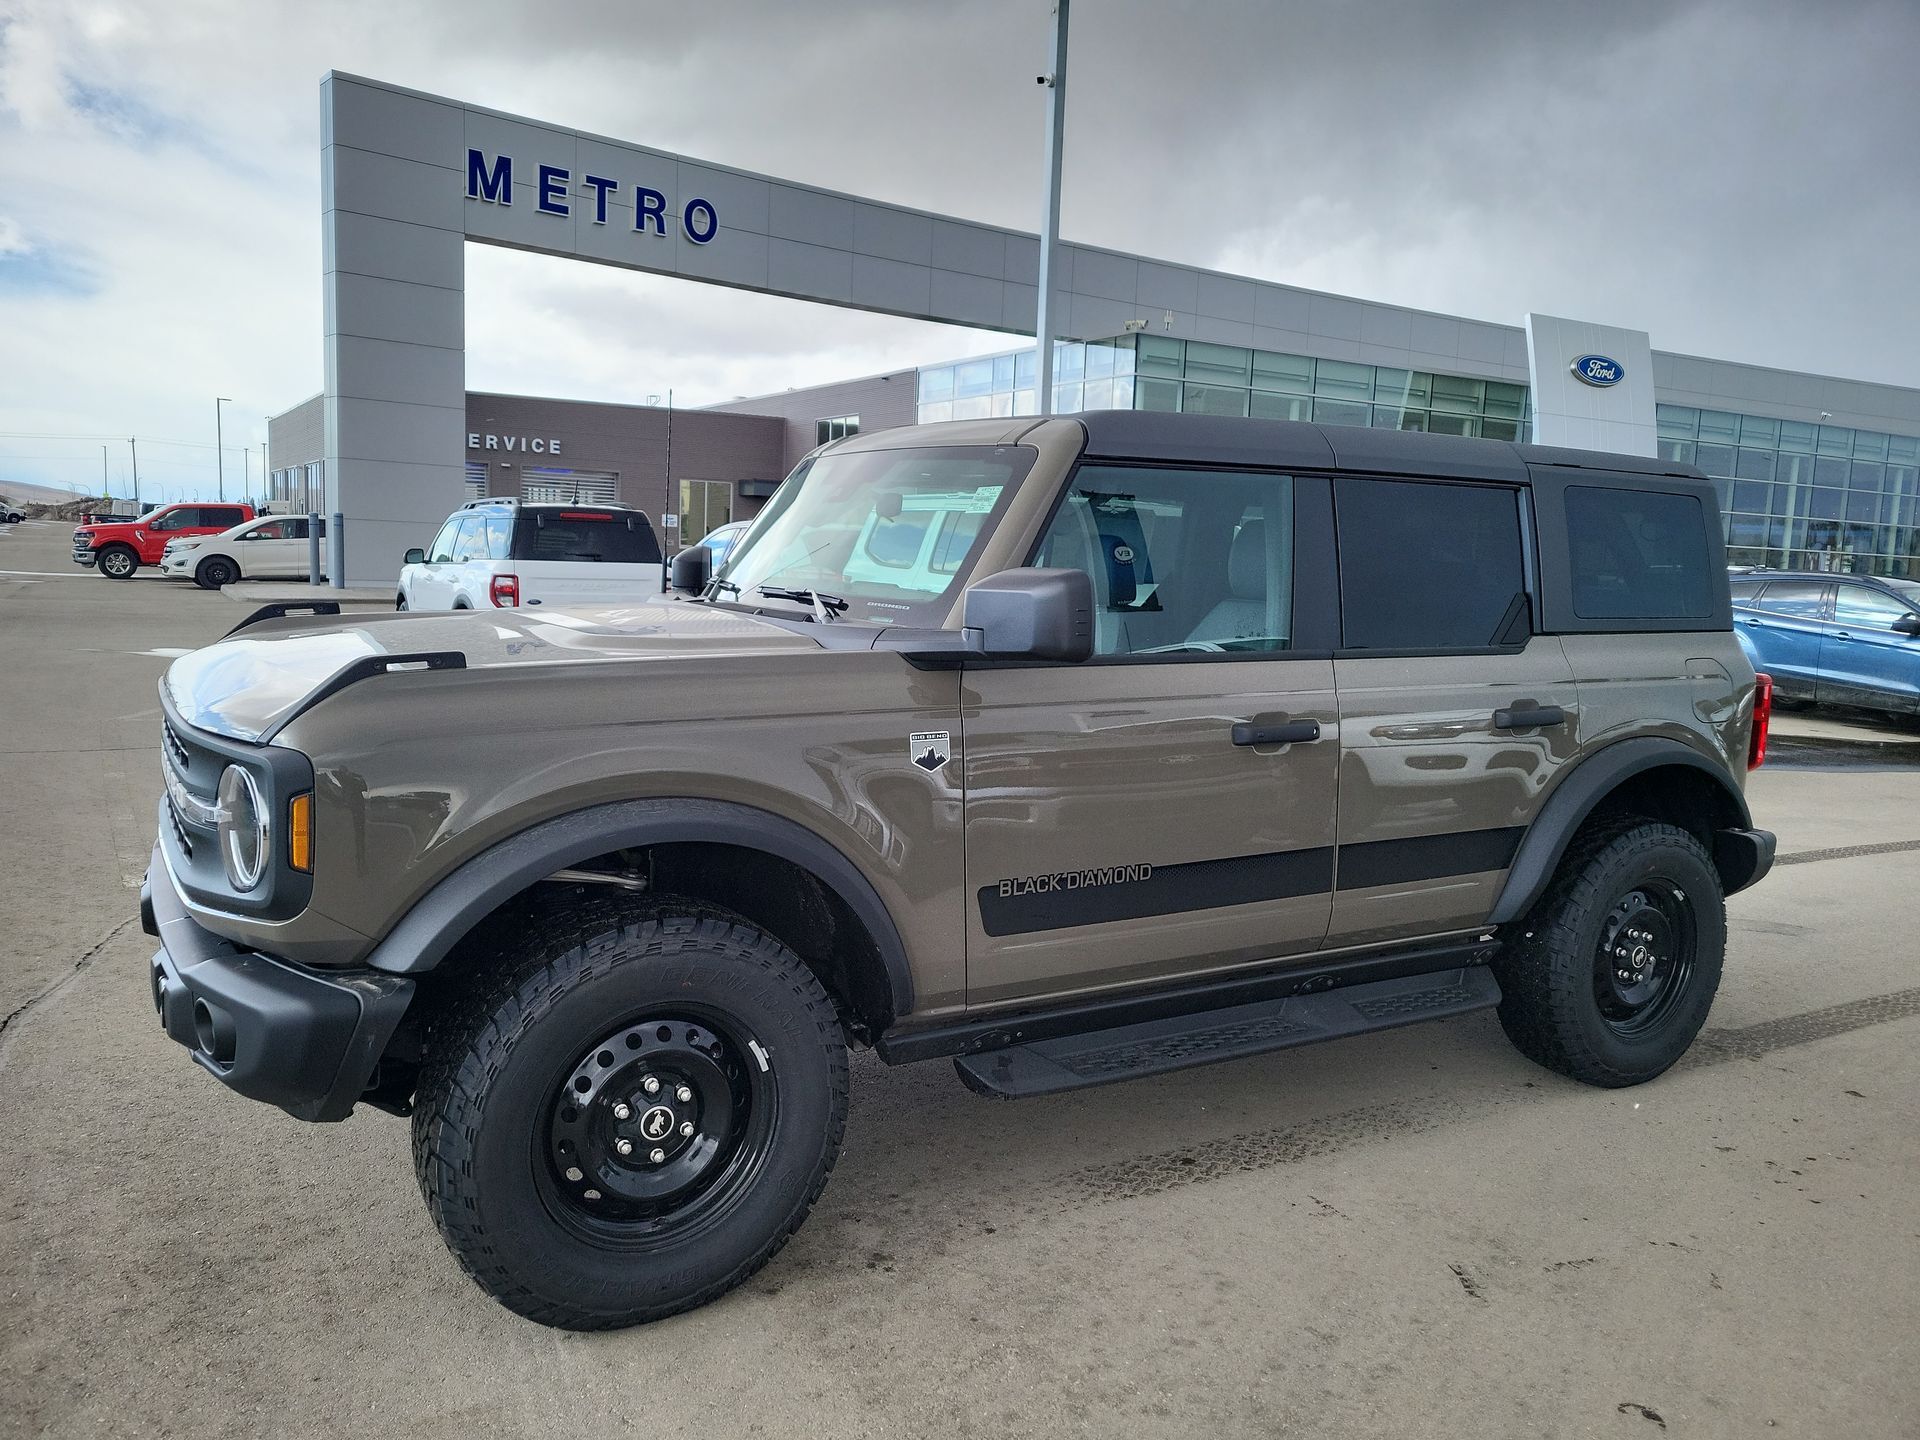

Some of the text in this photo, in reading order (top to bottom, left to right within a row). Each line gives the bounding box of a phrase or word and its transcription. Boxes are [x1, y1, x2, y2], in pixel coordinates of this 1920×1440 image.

[466, 148, 719, 245] METRO
[1587, 360, 1615, 379] Ford
[468, 433, 561, 454] ERVICE
[1000, 864, 1151, 897] BLACK DIAMOND
